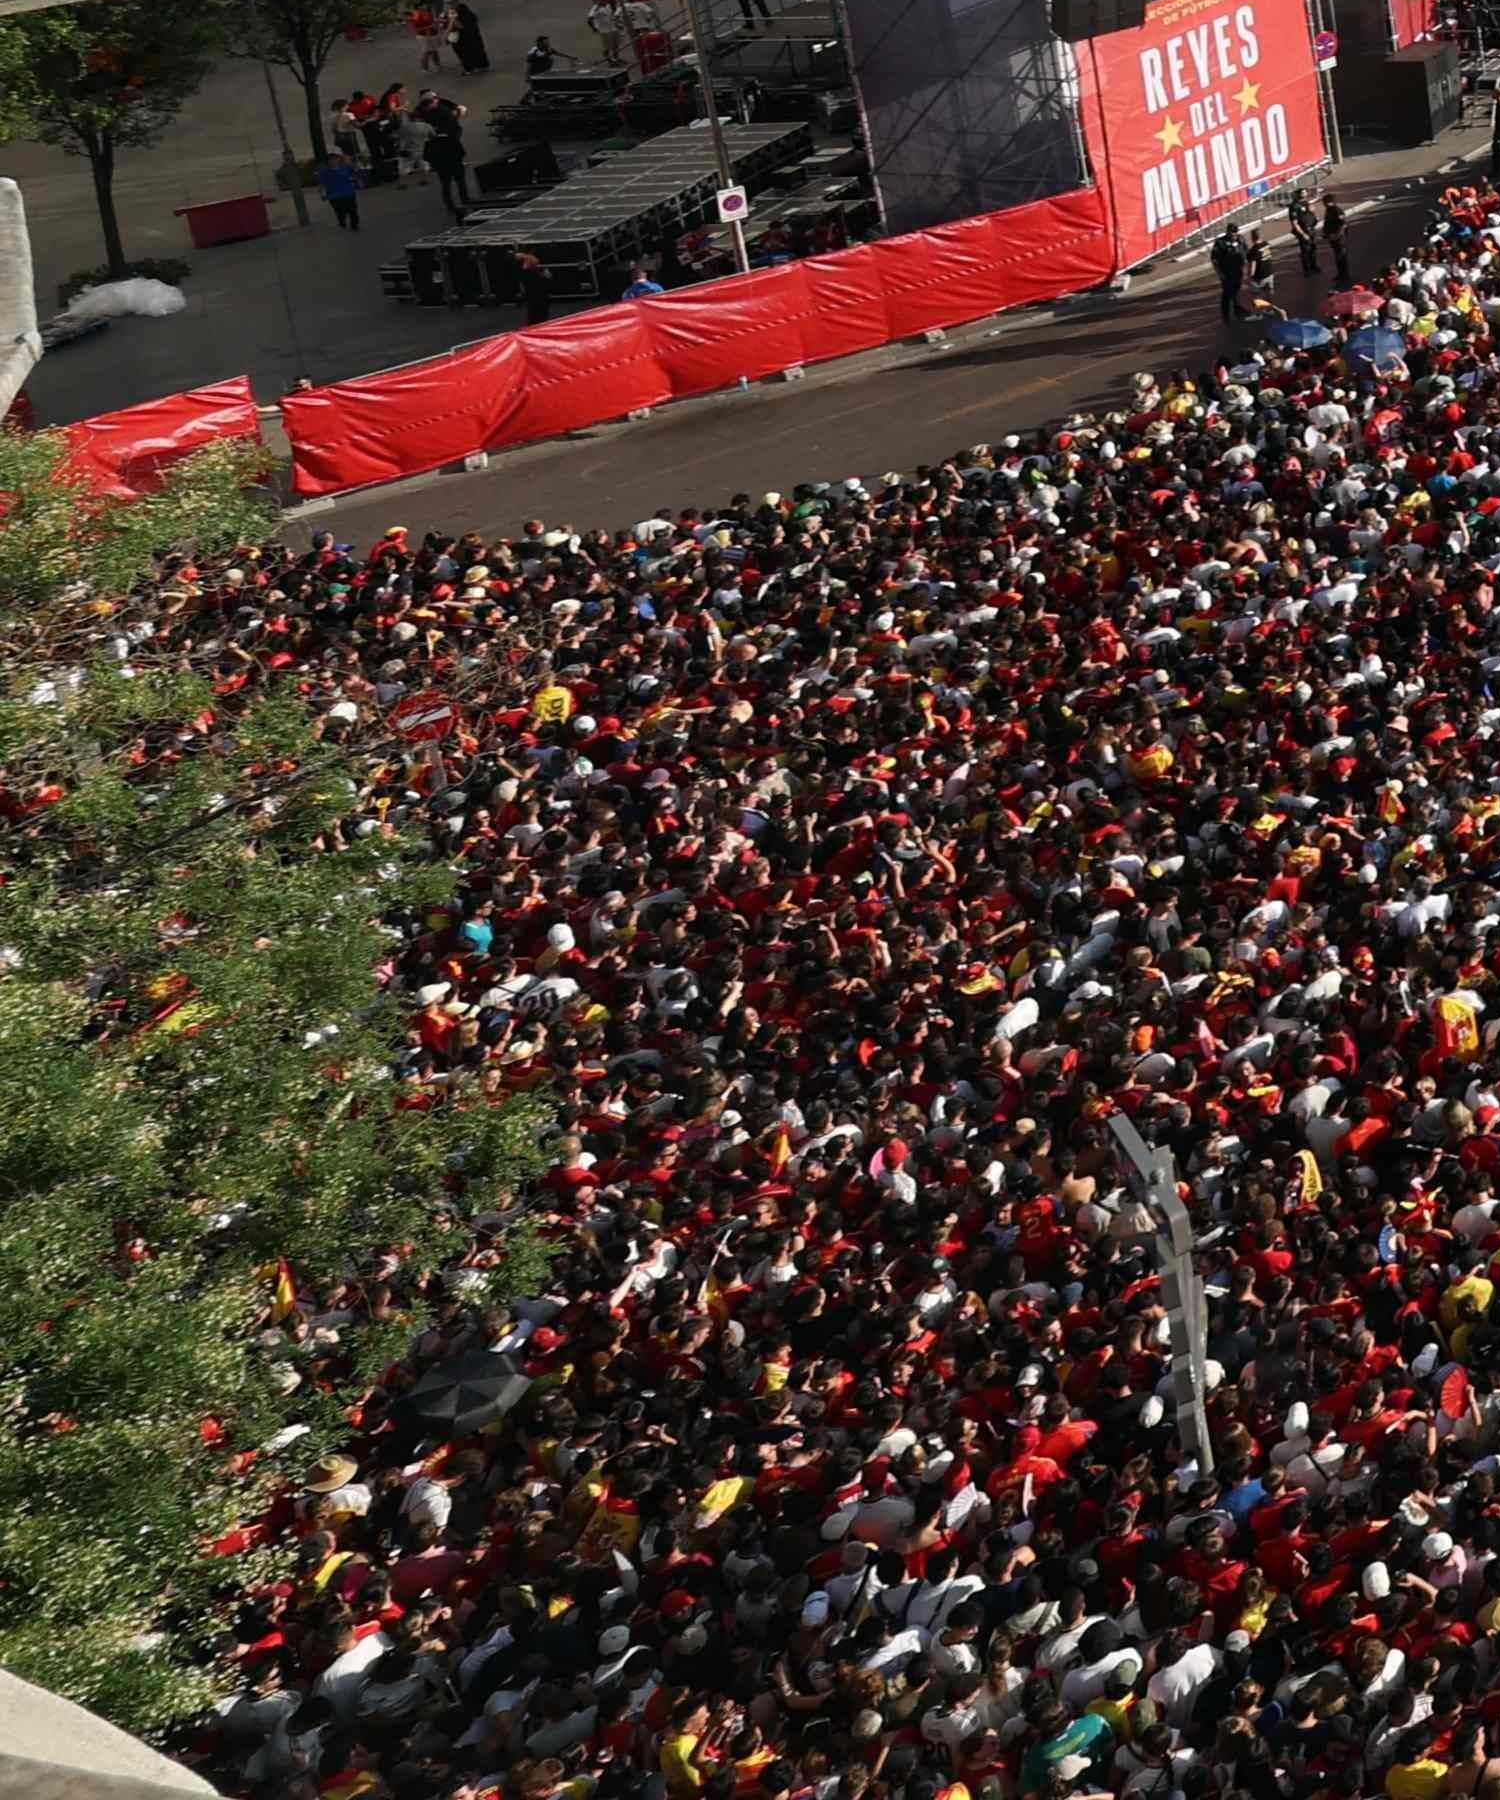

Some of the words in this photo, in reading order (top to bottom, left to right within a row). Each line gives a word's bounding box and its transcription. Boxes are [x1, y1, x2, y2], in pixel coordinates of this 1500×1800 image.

[1140, 5, 1260, 113] REYES
[1142, 104, 1289, 233] MUNDO
[1189, 92, 1229, 137] DEL
